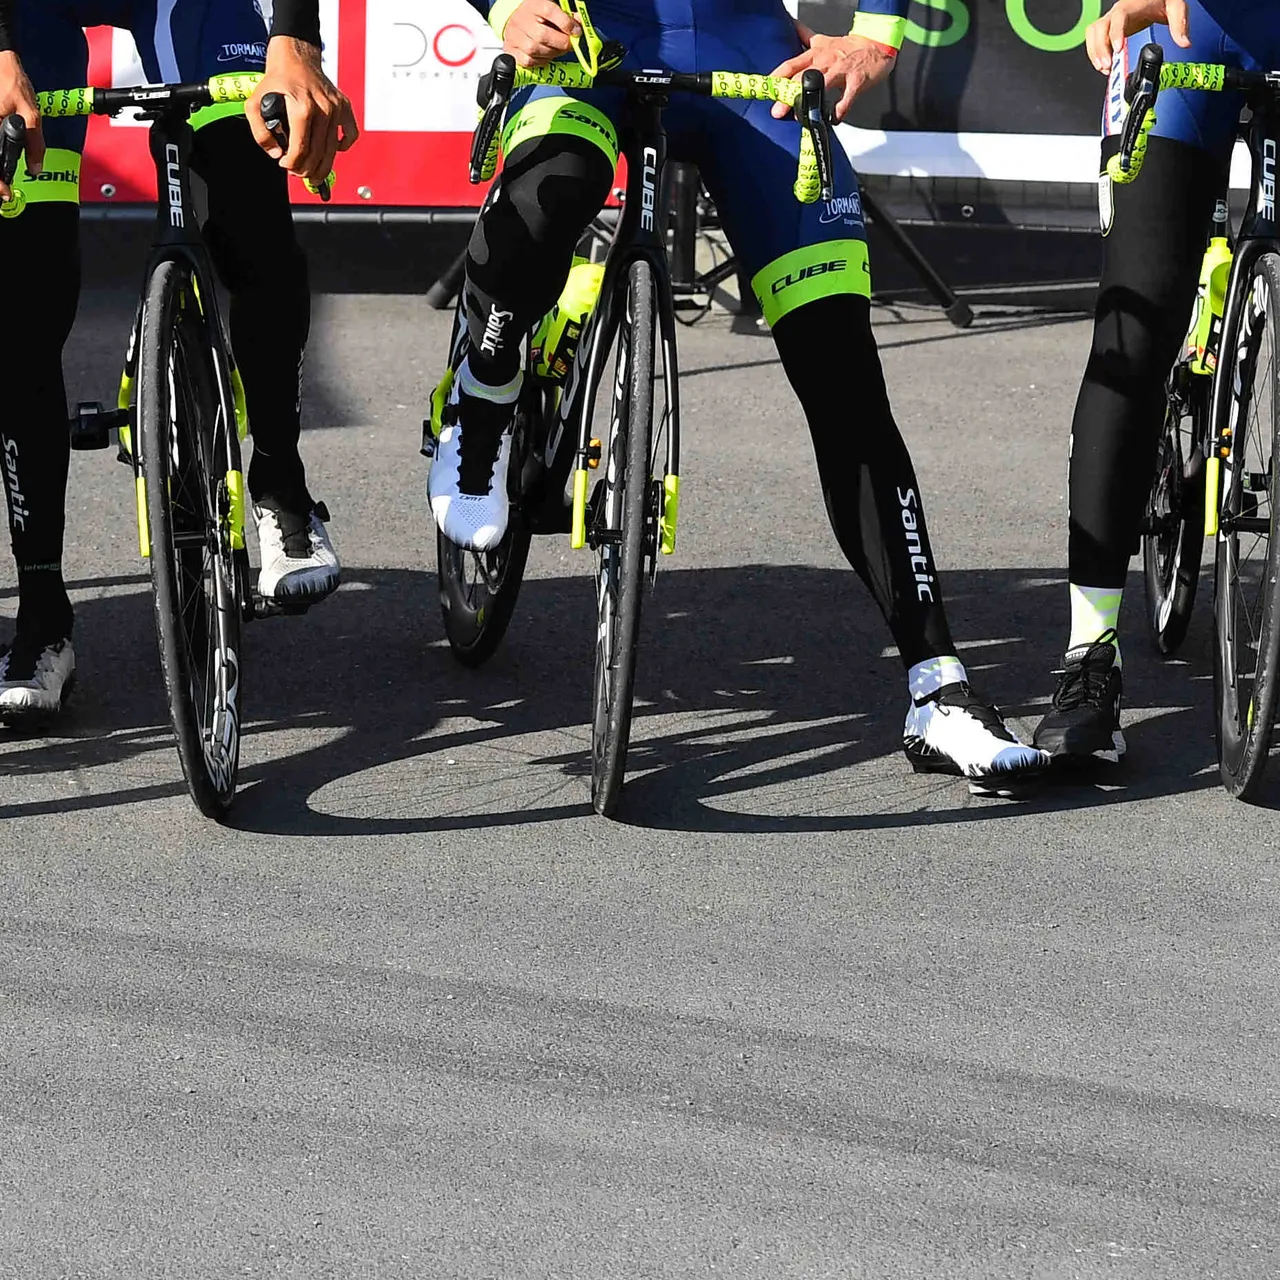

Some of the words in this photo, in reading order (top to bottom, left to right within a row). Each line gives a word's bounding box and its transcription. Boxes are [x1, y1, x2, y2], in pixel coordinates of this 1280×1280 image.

[133, 91, 170, 101] CUBE
[634, 75, 671, 85] CUBE
[166, 143, 184, 228] CUBE
[640, 147, 656, 232] CUBE
[1263, 138, 1276, 222] CUBE
[771, 260, 847, 295] CUBE
[479, 304, 513, 357] Santic
[2, 433, 24, 532] Santic
[896, 487, 933, 603] Santic
